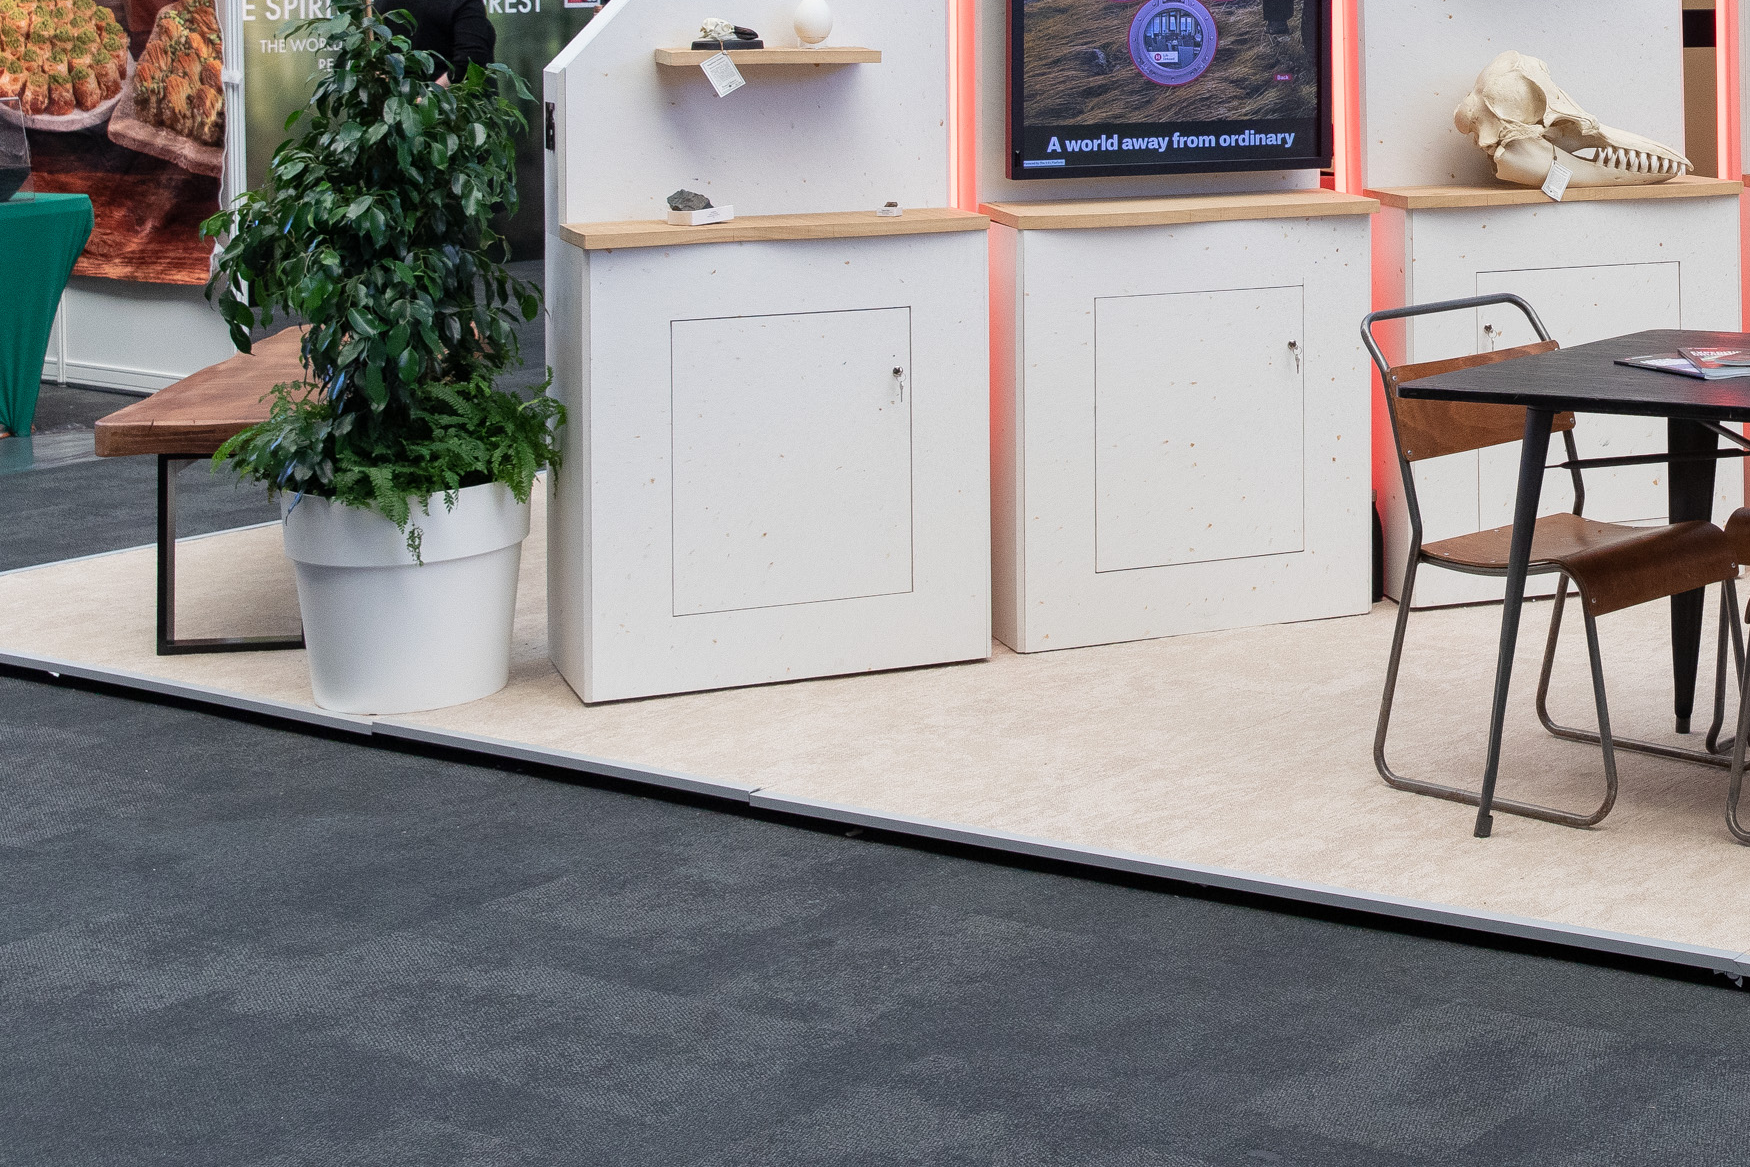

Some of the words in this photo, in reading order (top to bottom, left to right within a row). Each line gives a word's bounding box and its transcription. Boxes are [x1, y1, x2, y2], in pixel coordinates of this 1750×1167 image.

[260, 39, 286, 53] THE
[1047, 136, 1062, 153] A
[1065, 134, 1118, 152] world
[1122, 135, 1168, 152] away
[1172, 131, 1216, 149] from
[1219, 130, 1295, 148] ordinary
